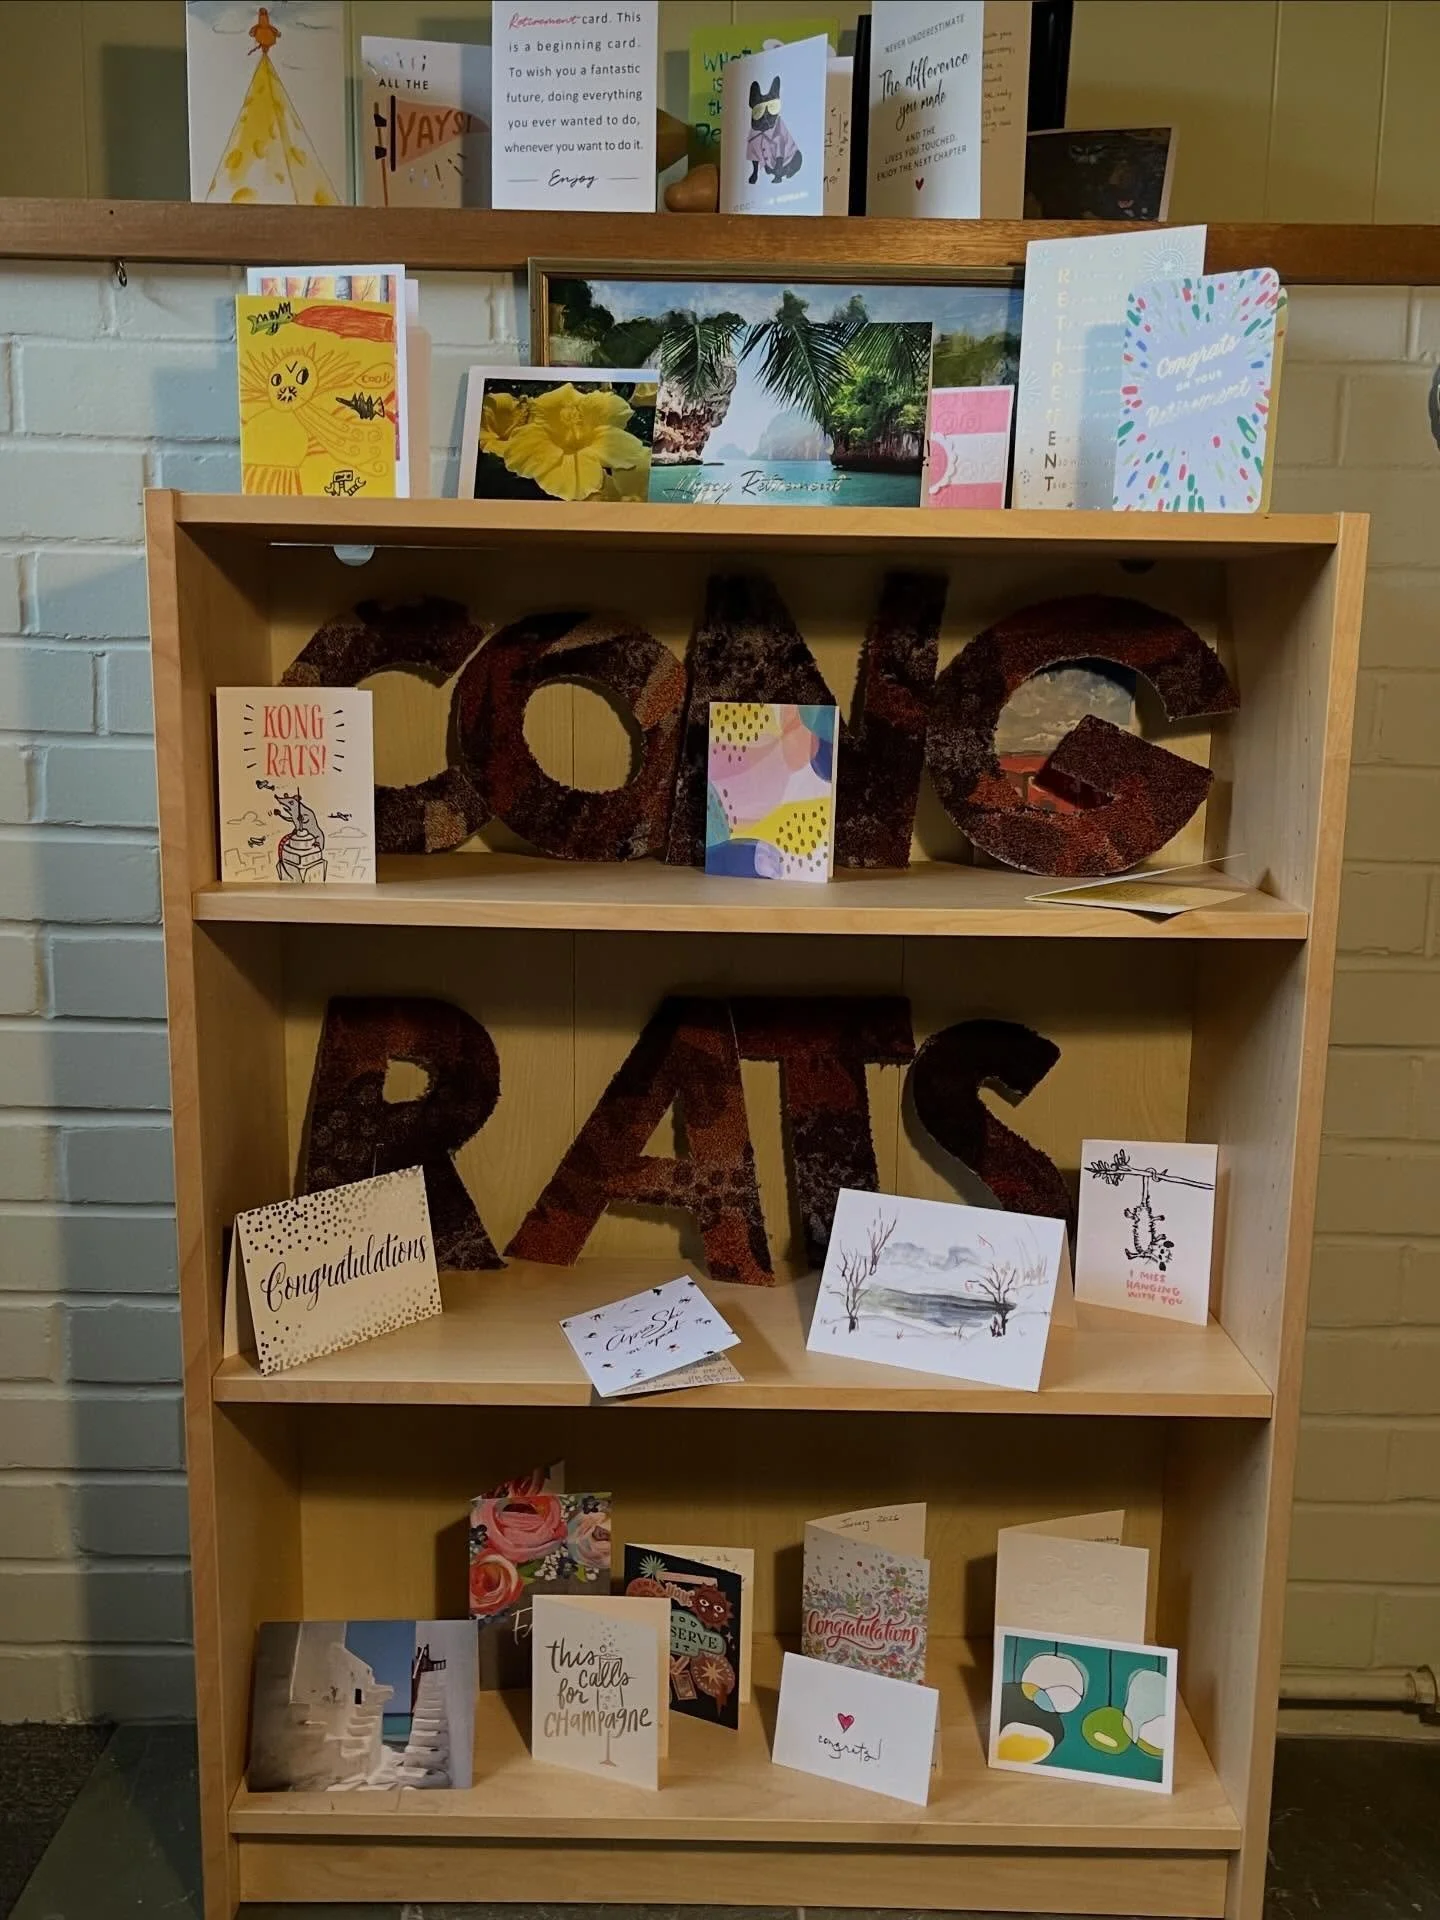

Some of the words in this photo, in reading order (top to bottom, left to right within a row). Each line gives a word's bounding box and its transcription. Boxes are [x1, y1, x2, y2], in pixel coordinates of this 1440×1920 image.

[508, 12, 580, 29] Retirement
[582, 12, 612, 25] card.
[616, 12, 641, 23] This
[508, 43, 519, 52] is
[525, 43, 531, 51] a
[537, 40, 602, 53] beginning
[607, 37, 642, 49] card.
[885, 39, 906, 54] NEVER
[906, 13, 965, 46] UNDERESTIMATE
[509, 67, 522, 78] To
[526, 66, 552, 77] wish
[556, 67, 576, 78] you
[580, 66, 587, 75] a
[591, 63, 641, 75] fantastic
[878, 69, 901, 104] The
[905, 53, 970, 91] difference
[378, 77, 400, 89] ALL
[406, 80, 429, 90] THE
[506, 91, 544, 104] future,
[548, 89, 579, 103] doing
[582, 87, 643, 102] everything
[895, 99, 917, 131] you
[920, 79, 946, 111] made
[508, 119, 528, 131] you
[532, 118, 556, 128] ever
[560, 115, 603, 126] wanted
[606, 115, 618, 125] to
[622, 114, 640, 126] do,
[905, 131, 920, 143] AND
[922, 126, 936, 138] THE
[504, 142, 553, 153] whenever
[556, 143, 575, 154] you
[577, 141, 601, 151] want
[605, 140, 616, 151] to
[618, 140, 631, 150] do
[634, 140, 643, 150] it.
[885, 152, 902, 165] LIVES
[904, 147, 919, 160] YOU
[876, 168, 897, 182] ENJOY
[899, 163, 913, 174] THE
[914, 155, 931, 169] NEXT
[933, 144, 967, 163] CHAPTER
[548, 168, 600, 188] Enjoy
[1156, 334, 1240, 378] Congrats
[1194, 370, 1222, 385] YOUR
[1146, 377, 1251, 428] Retirement
[263, 704, 324, 740] KONG
[266, 742, 327, 778] RATS!
[304, 996, 1076, 1289] RATS
[260, 1233, 428, 1312] Congratulations
[1140, 1271, 1166, 1282] MISS
[1126, 1280, 1180, 1296] HANGING
[1127, 1291, 1155, 1302] WITH
[1161, 1295, 1183, 1305] YOU
[808, 1602, 919, 1651] Congratulations
[545, 1637, 601, 1673] this
[578, 1661, 637, 1689] calls
[557, 1678, 589, 1710] for
